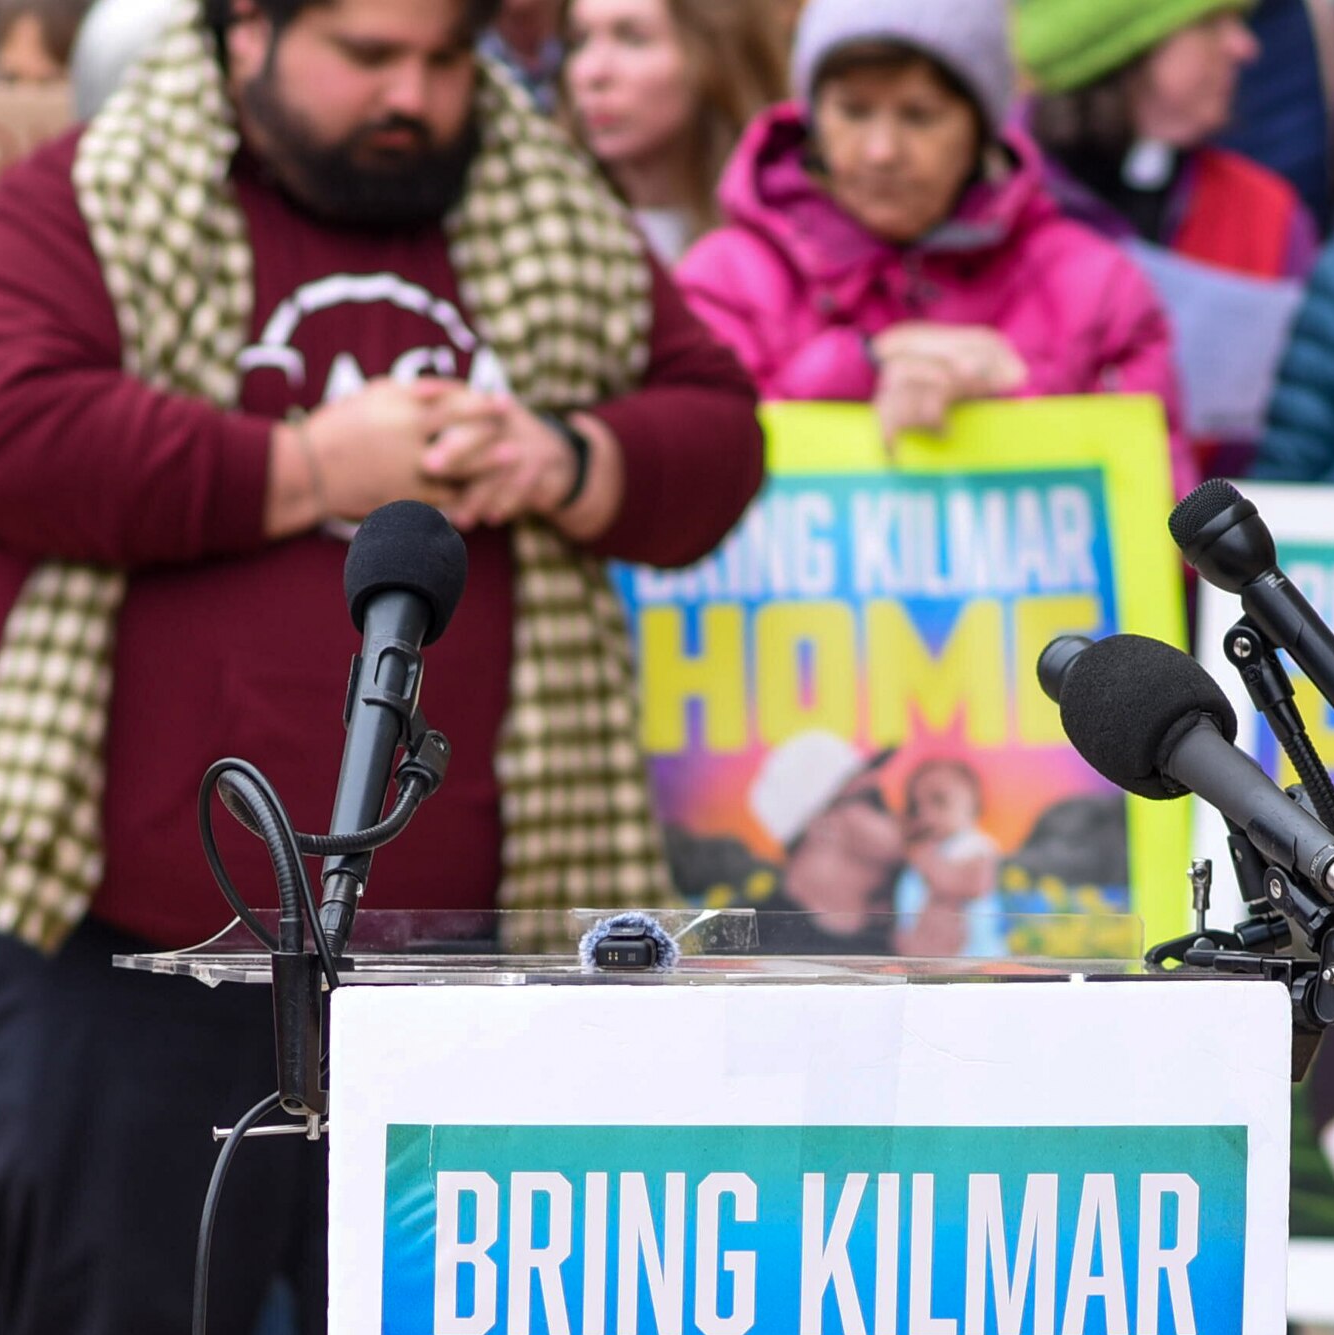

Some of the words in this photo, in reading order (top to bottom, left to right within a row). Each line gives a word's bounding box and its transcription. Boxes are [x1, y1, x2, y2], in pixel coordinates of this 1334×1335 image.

[634, 490, 835, 600] ING
[850, 486, 1098, 598] KILMAR
[639, 595, 1103, 754] HOME
